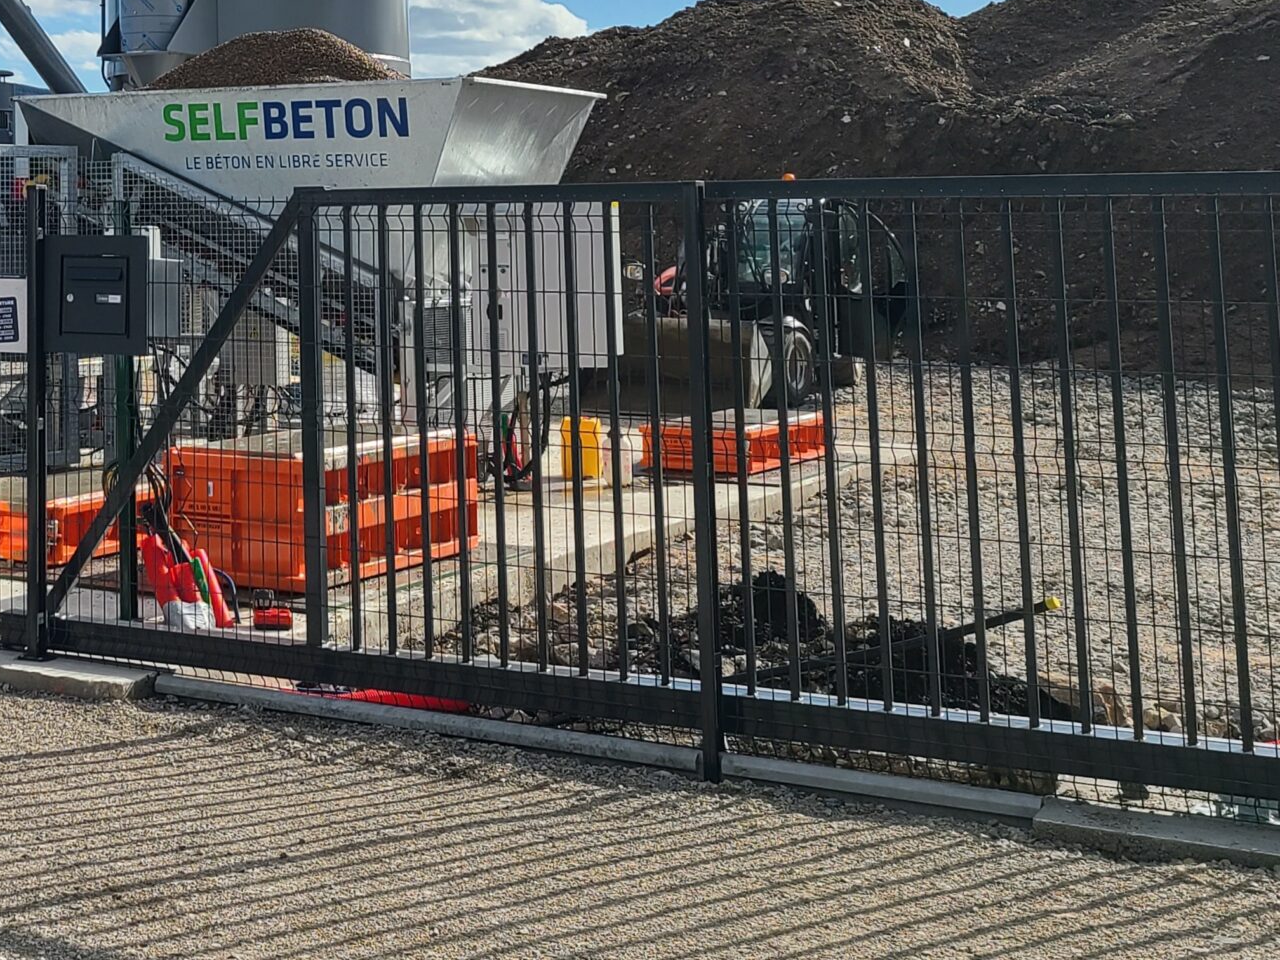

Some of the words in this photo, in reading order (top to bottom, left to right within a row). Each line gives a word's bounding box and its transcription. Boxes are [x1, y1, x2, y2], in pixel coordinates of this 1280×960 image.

[163, 97, 410, 142] SELFBETON
[185, 156, 201, 170] LE
[206, 153, 251, 170] BÉTON
[256, 155, 275, 169] EN
[279, 153, 320, 169] LIBRE
[325, 152, 389, 168] SERVICE
